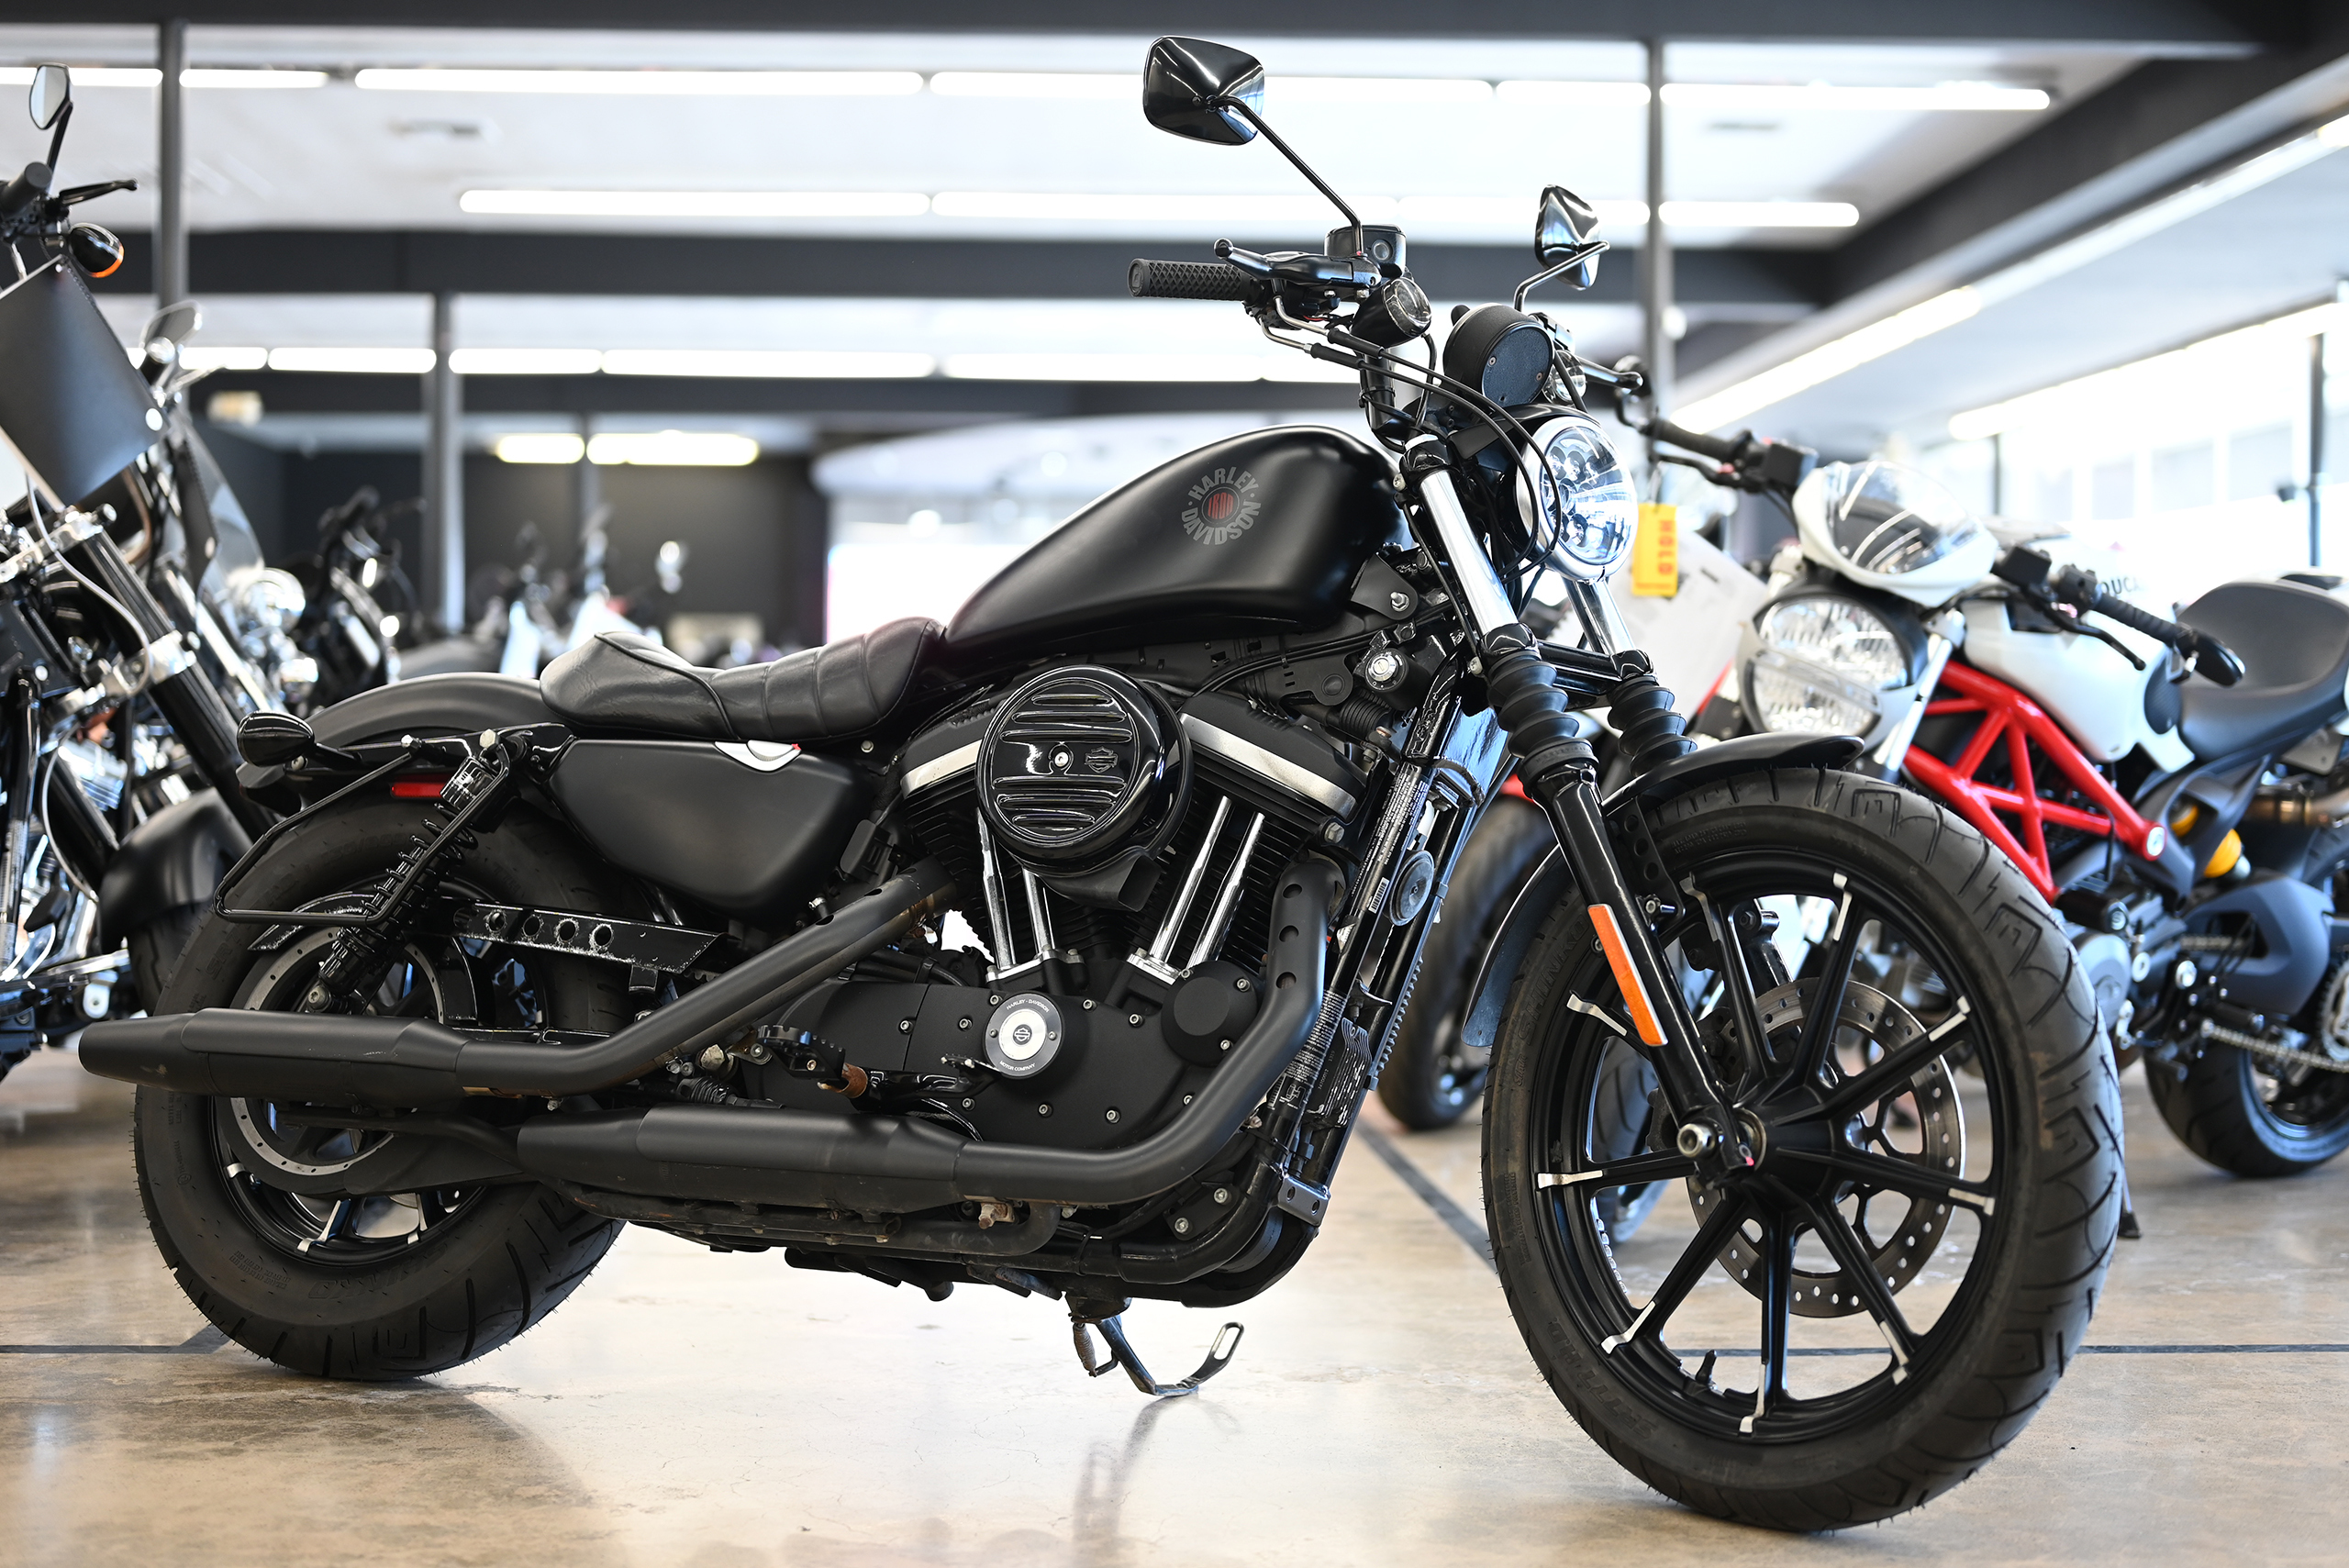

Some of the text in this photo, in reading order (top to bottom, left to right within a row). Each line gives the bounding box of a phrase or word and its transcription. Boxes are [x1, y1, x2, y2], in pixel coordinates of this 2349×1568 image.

[1188, 466, 1259, 501] HARLEY
[1181, 499, 1262, 545] DAVIDSON
[1516, 914, 1591, 1045] SHINKO
[999, 1061, 1035, 1072] MOTOR COMPANY
[1575, 1367, 1657, 1441] SR777
